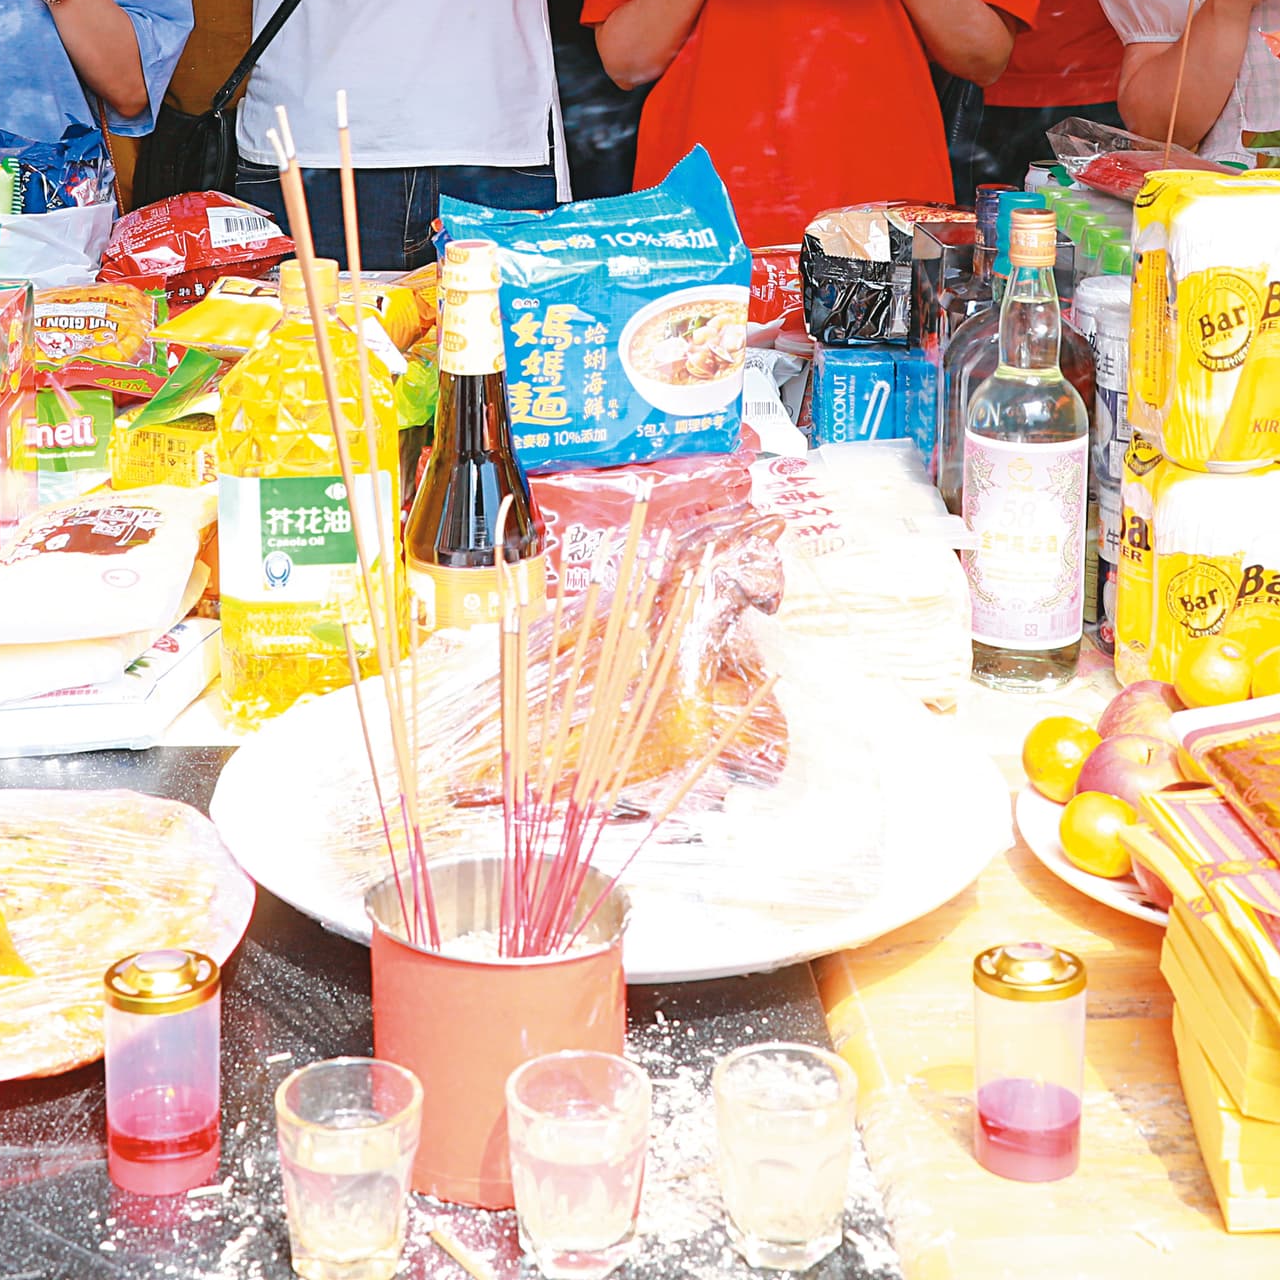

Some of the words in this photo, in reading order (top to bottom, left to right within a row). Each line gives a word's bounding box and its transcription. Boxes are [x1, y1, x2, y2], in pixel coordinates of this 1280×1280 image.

[602, 228, 718, 249] 10%添加
[1197, 304, 1246, 342] Bar
[833, 374, 847, 443] COCONUT
[266, 505, 352, 535] 芥花油
[1179, 588, 1219, 613] Bar
